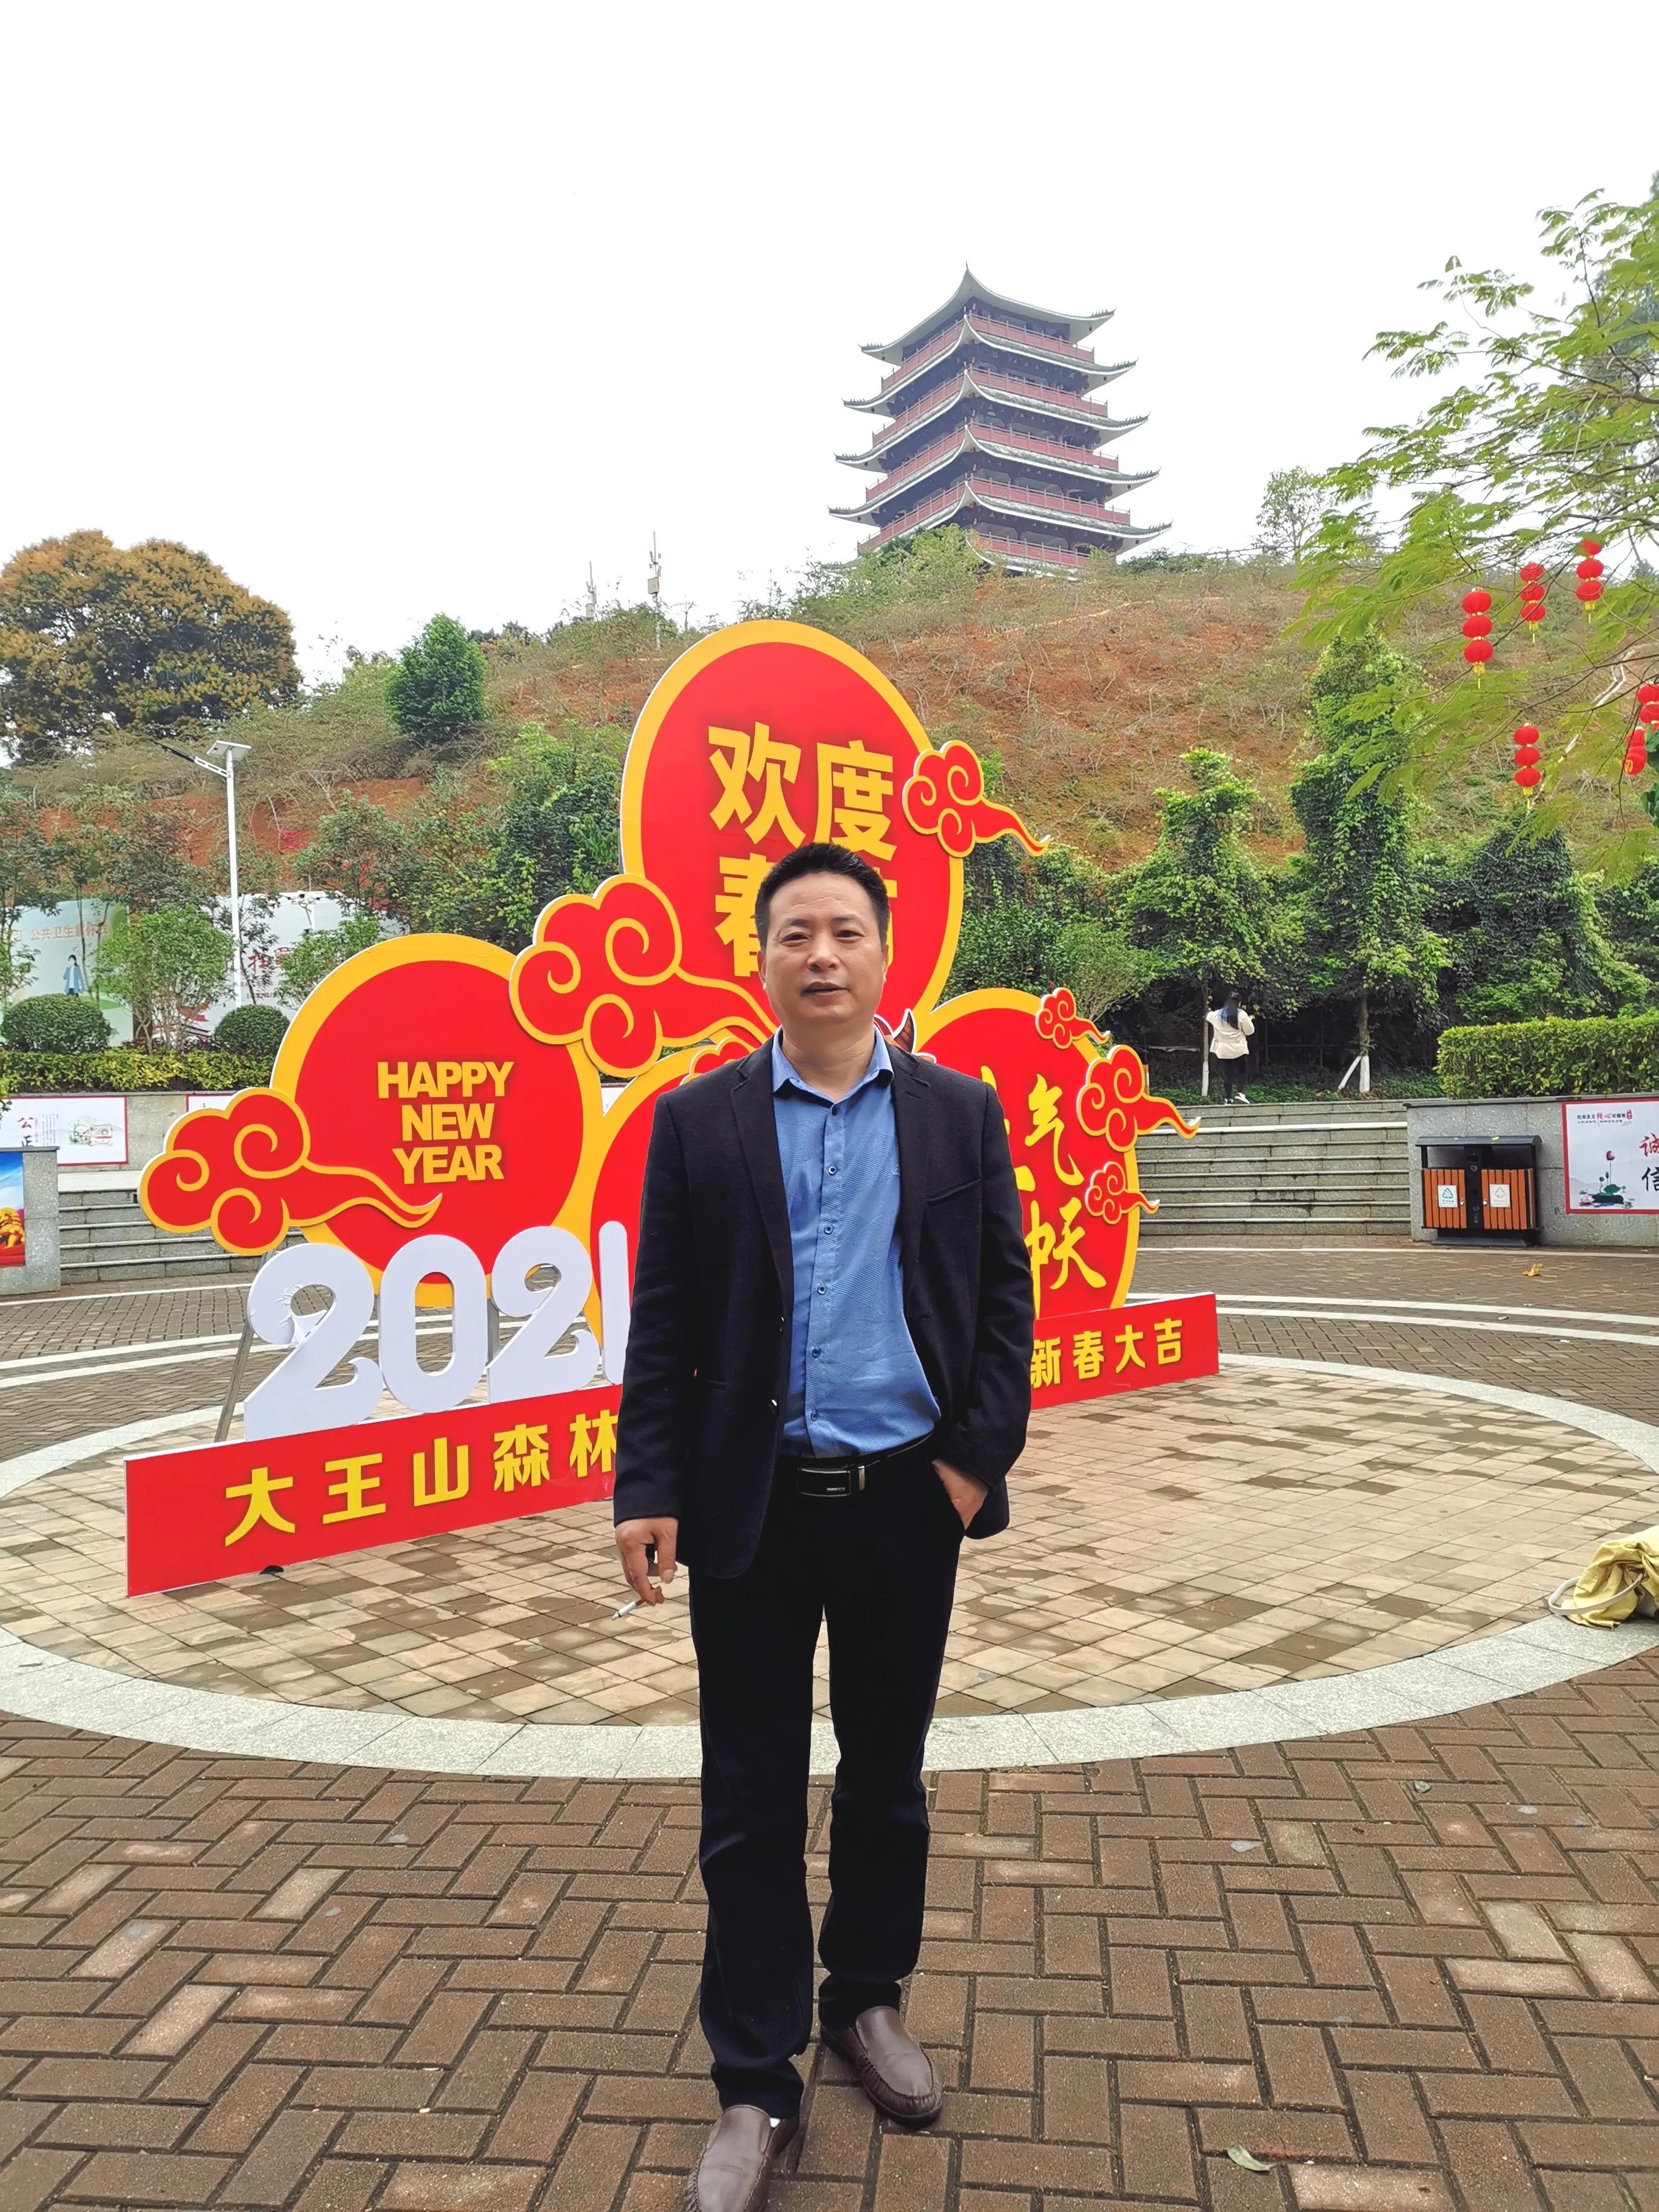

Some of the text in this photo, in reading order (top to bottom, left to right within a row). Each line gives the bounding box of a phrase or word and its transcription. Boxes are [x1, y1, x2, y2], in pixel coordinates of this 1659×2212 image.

[708, 722, 897, 860] 欢度
[377, 1062, 514, 1099] HAPPY
[401, 1102, 495, 1142] NEW
[392, 1144, 504, 1185] YEAR
[244, 1219, 631, 1442] 2021
[1030, 1318, 1182, 1389] 新春大吉
[224, 1409, 618, 1547] 大王山森林
